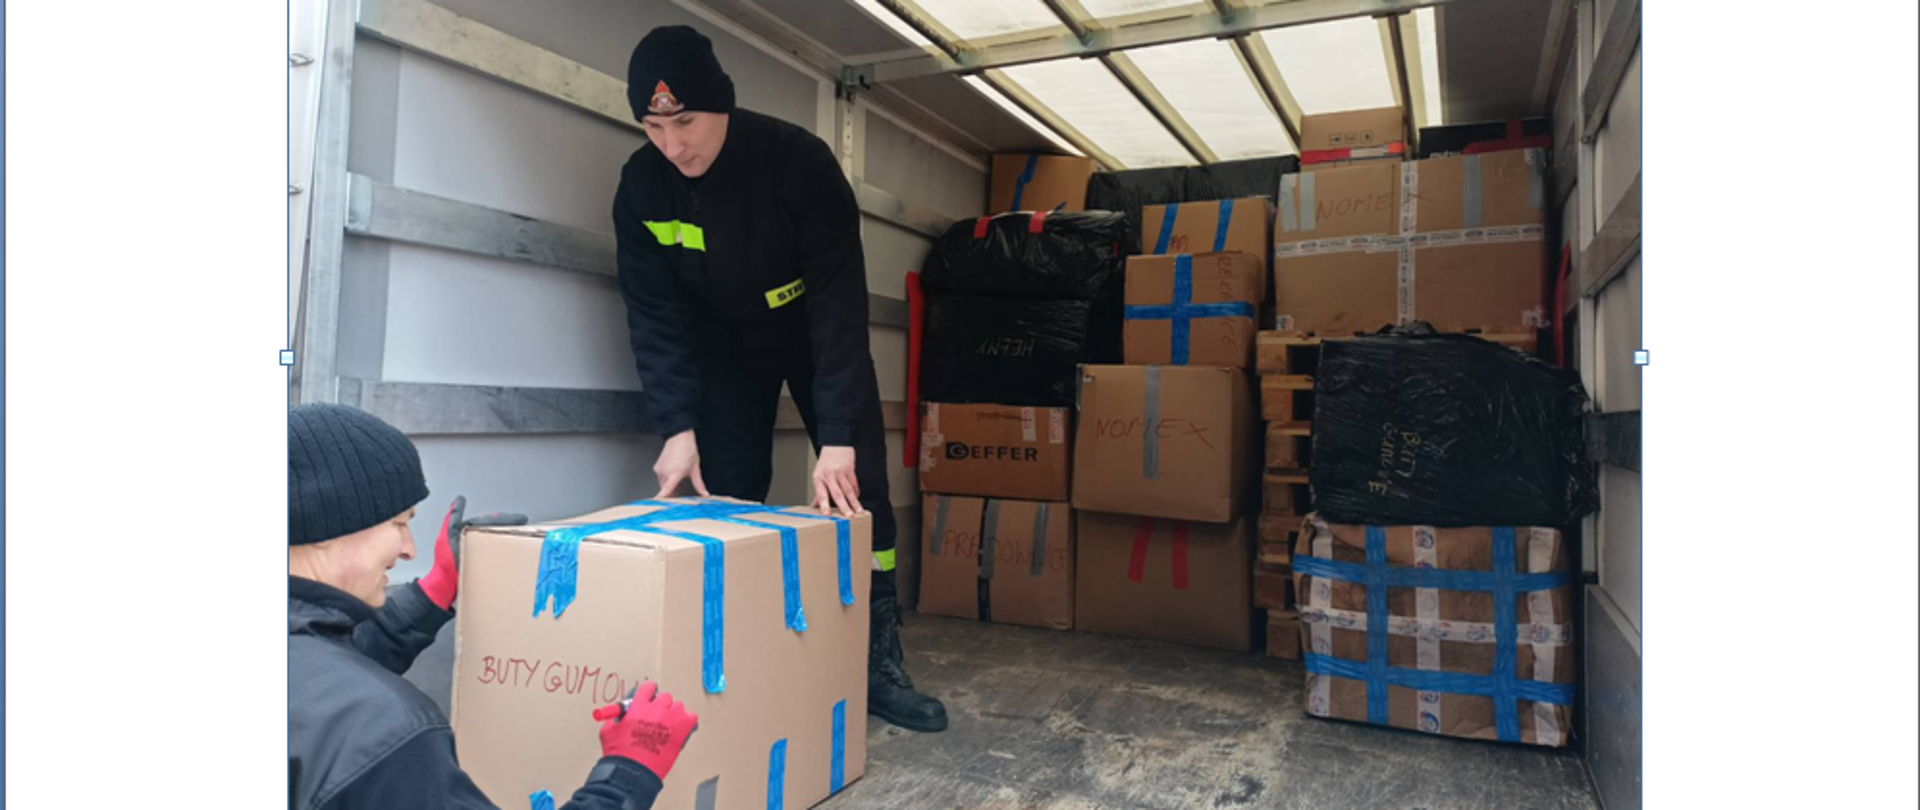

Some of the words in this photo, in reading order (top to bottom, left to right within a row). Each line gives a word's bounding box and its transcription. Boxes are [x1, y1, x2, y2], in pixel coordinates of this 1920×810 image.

[1094, 416, 1216, 451] NOMEX
[945, 441, 1039, 461] GEFFER
[477, 655, 541, 688] BUTY
